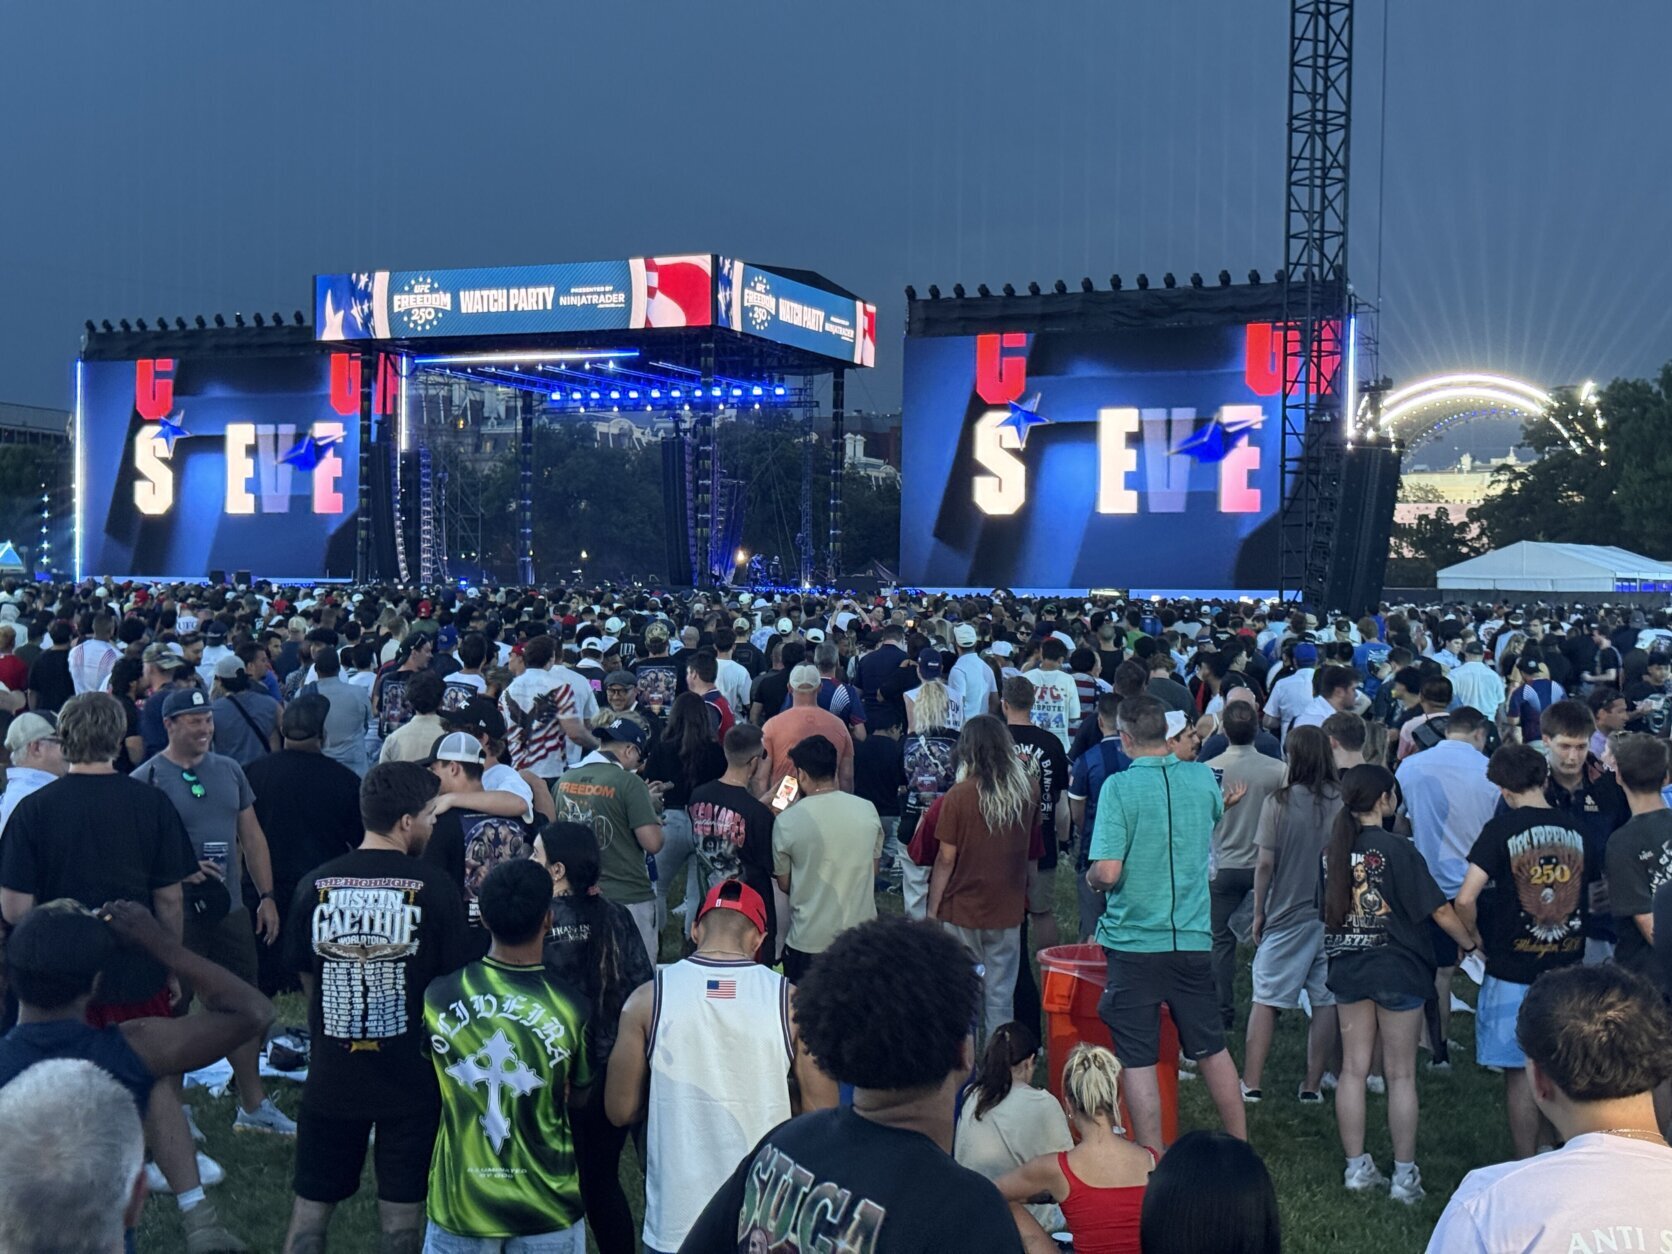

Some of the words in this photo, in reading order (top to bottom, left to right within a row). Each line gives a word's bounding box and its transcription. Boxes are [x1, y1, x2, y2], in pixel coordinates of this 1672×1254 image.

[393, 292, 451, 312] FREEDOM
[459, 288, 508, 314] WATCH
[509, 286, 556, 311] PARTY
[559, 293, 625, 307] NINJATRADER
[411, 308, 436, 324] 250
[753, 307, 768, 323] 250
[779, 298, 803, 327] WATCH
[803, 306, 825, 332] PARTY
[178, 621, 198, 630] UFC
[560, 782, 616, 799] FREEDOM
[1531, 825, 1584, 854] FREEDOM
[1530, 864, 1571, 885] 250
[328, 888, 404, 912] JUSTIN
[312, 903, 422, 945] GAETHJE
[337, 935, 366, 945] WORLD
[367, 935, 389, 945] TOUR
[1568, 1226, 1646, 1254] ANTI
